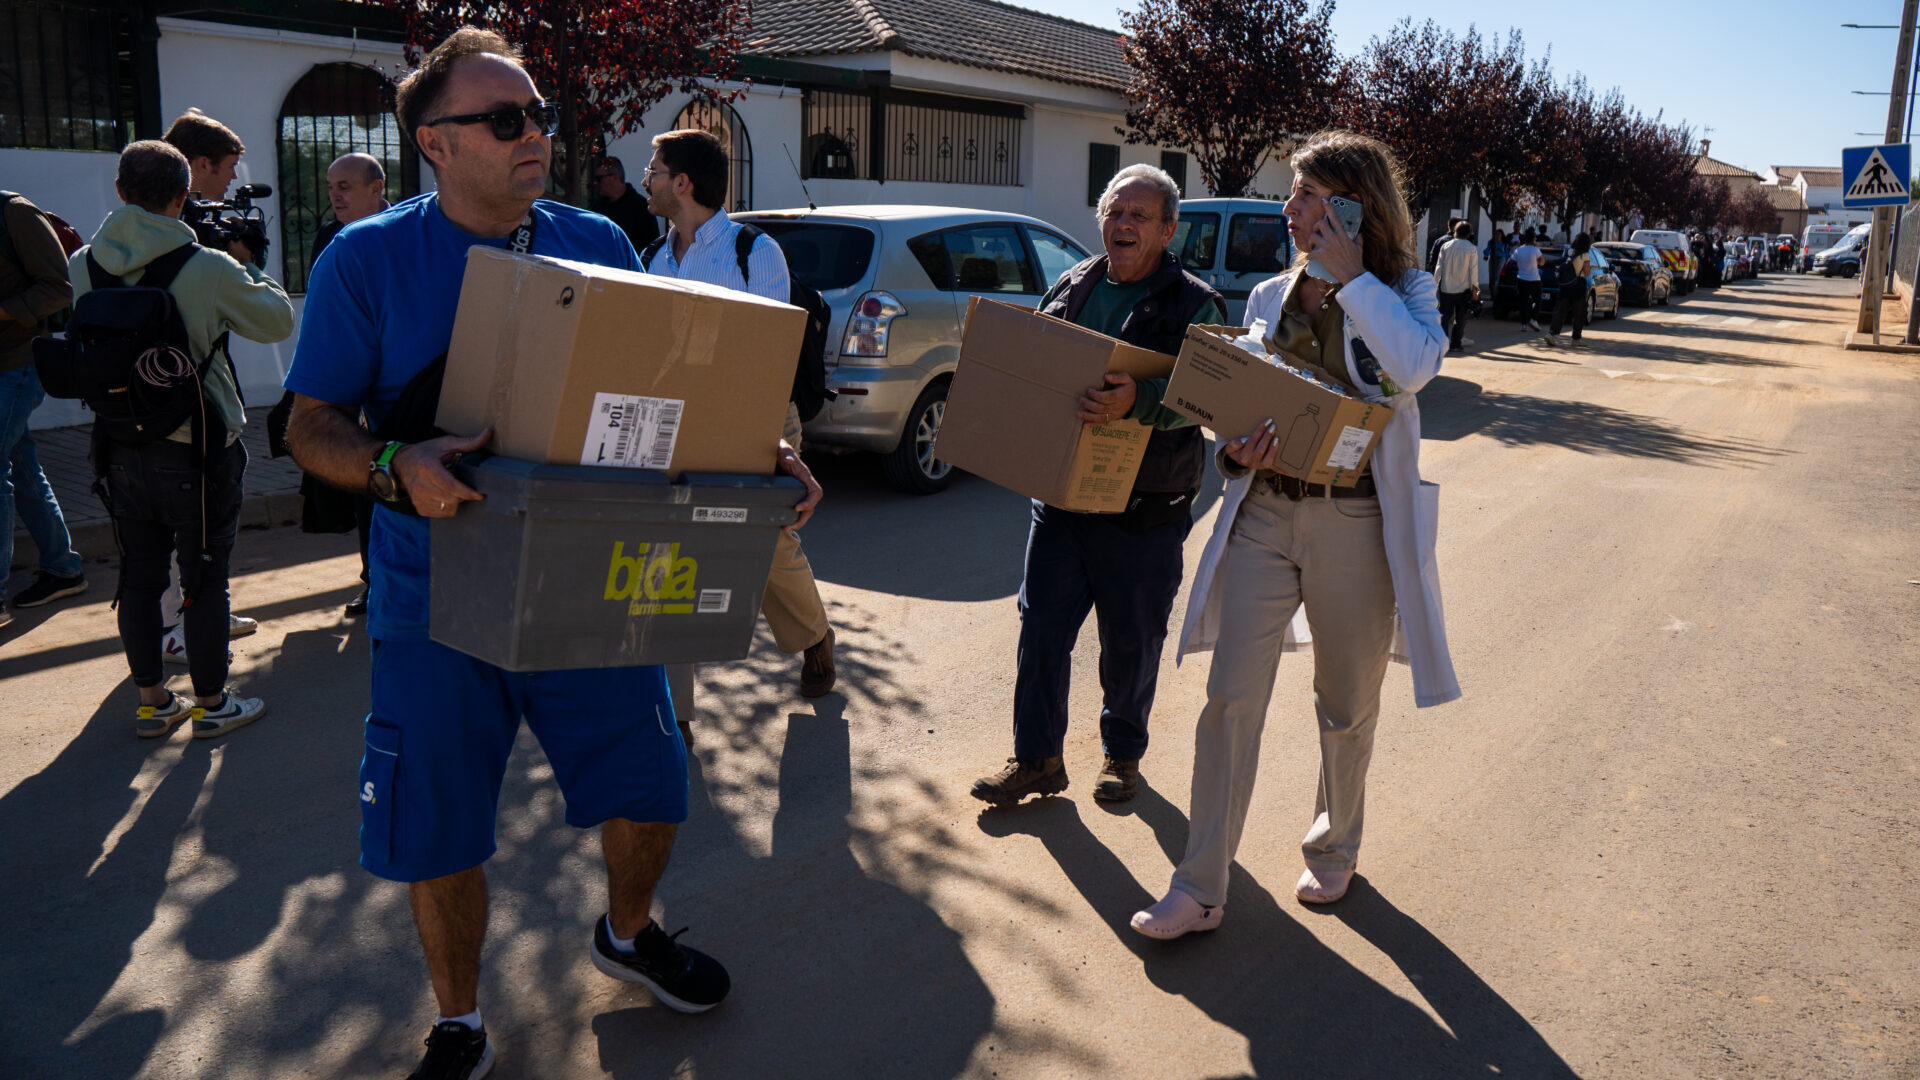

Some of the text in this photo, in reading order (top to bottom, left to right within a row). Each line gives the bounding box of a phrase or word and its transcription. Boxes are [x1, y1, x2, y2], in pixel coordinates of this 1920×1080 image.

[608, 403, 624, 428] 104
[1185, 401, 1214, 421] BRAUN
[604, 541, 698, 600] bida
